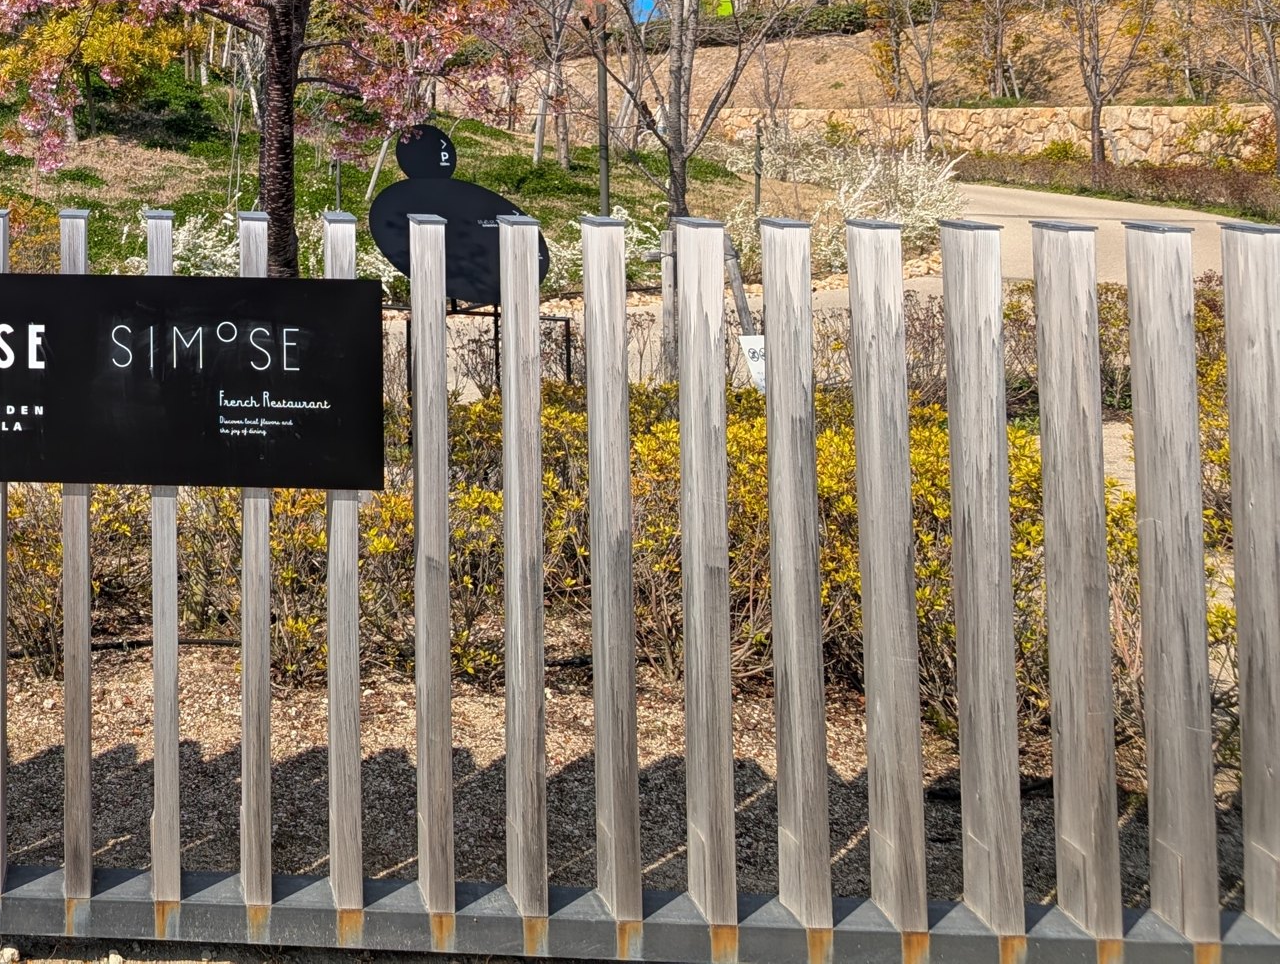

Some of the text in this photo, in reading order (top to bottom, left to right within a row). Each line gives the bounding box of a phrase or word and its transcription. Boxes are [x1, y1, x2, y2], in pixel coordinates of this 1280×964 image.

[440, 151, 449, 162] P
[219, 389, 331, 409] French Restaurant
